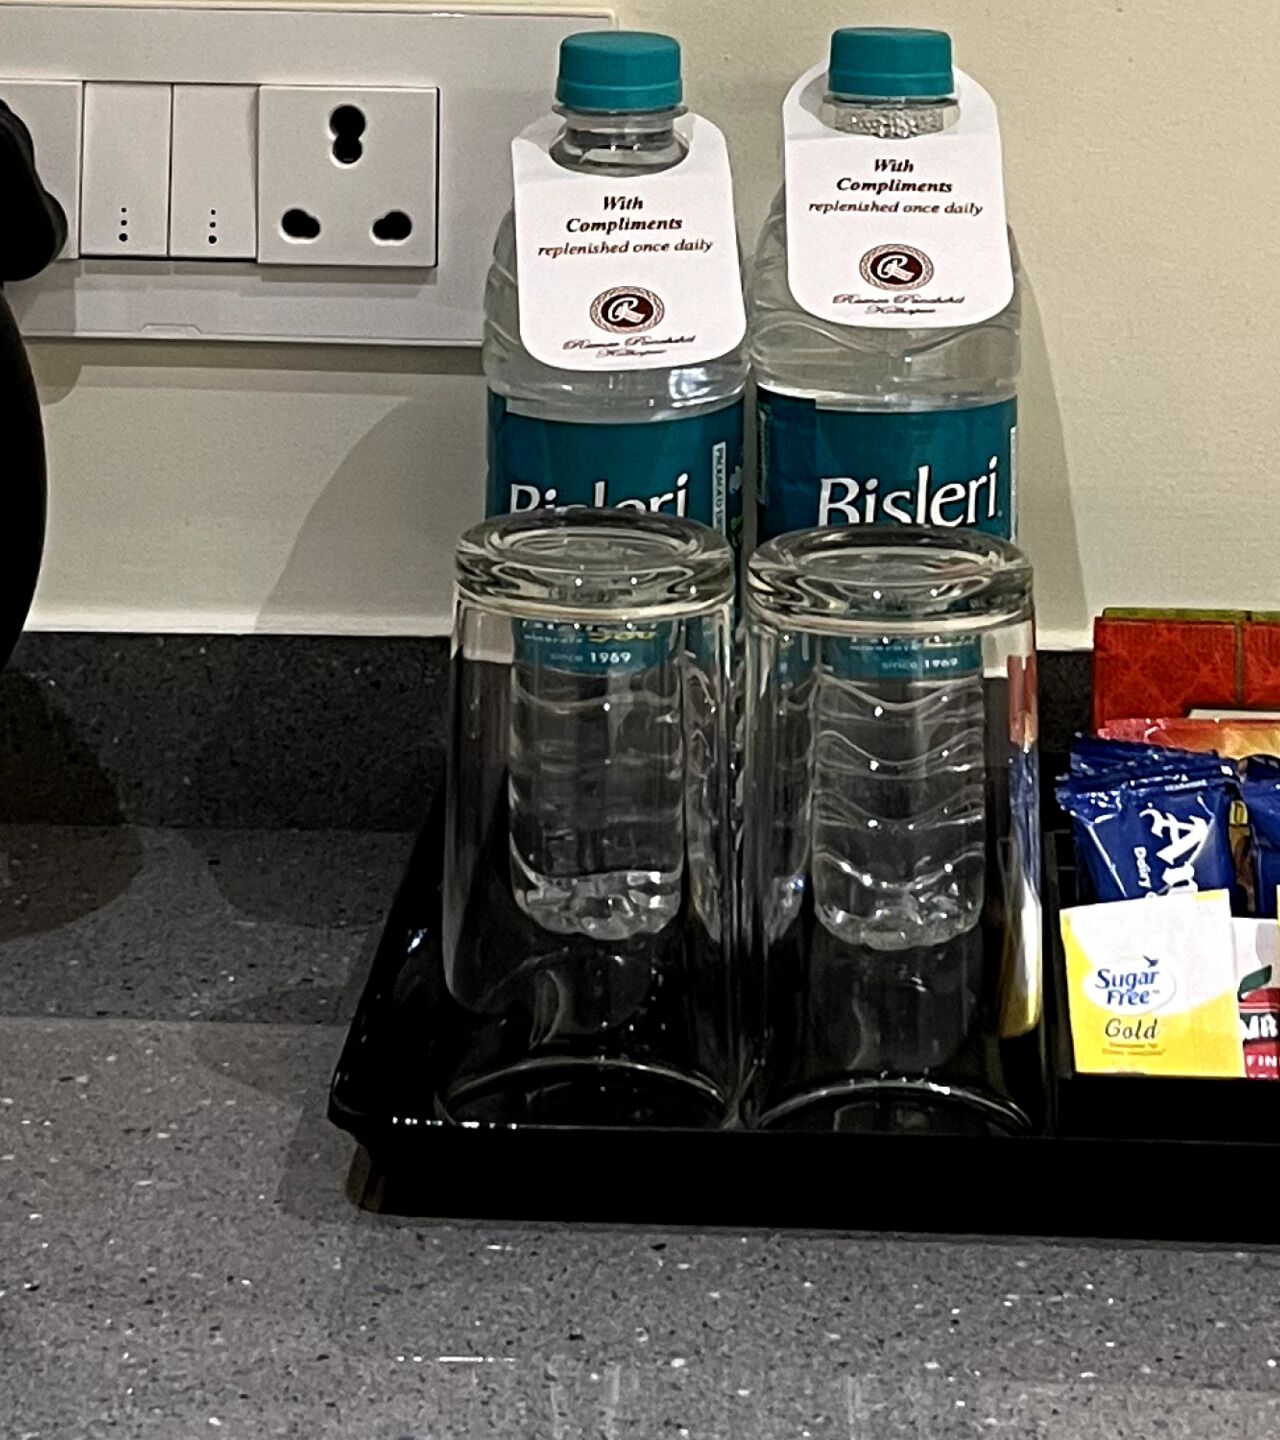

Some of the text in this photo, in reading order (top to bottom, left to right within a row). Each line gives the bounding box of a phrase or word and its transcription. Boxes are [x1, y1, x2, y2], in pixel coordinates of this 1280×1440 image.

[874, 159, 914, 173] With
[836, 177, 952, 195] Compliments
[603, 196, 644, 210] With
[808, 200, 984, 217] replenished once daily
[566, 217, 683, 235] Compliments
[537, 238, 714, 259] replenished once daily
[818, 456, 998, 527] Bisleri
[589, 651, 632, 664] 1969
[1095, 969, 1160, 990] Sugar
[1107, 989, 1150, 1006] Free
[1105, 1018, 1158, 1040] Gold
